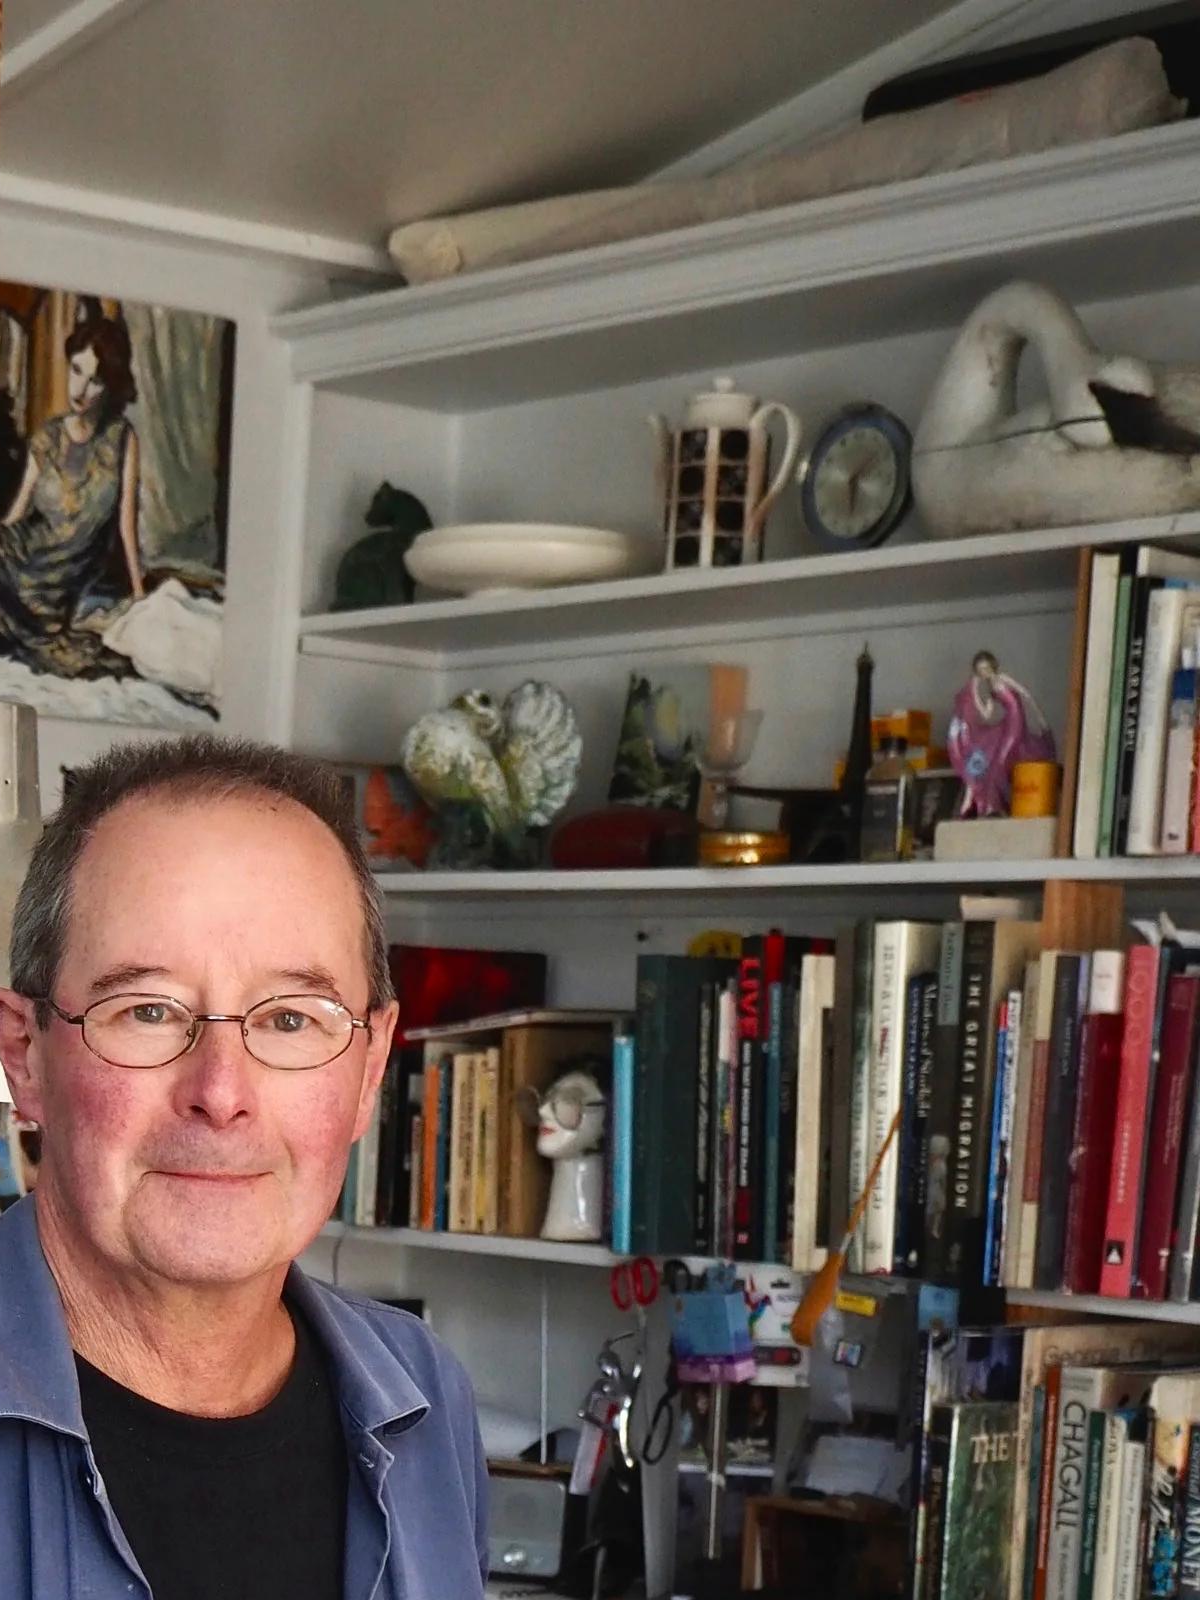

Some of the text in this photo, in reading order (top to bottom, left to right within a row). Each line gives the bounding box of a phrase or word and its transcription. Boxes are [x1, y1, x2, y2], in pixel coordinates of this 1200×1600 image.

[737, 958, 761, 1040] LIVE
[955, 973, 982, 1208] THE GREAT MIGRATION
[970, 1430, 1009, 1464] THE
[1055, 1401, 1087, 1531] CHAGALL
[1181, 1501, 1200, 1592] MONET
